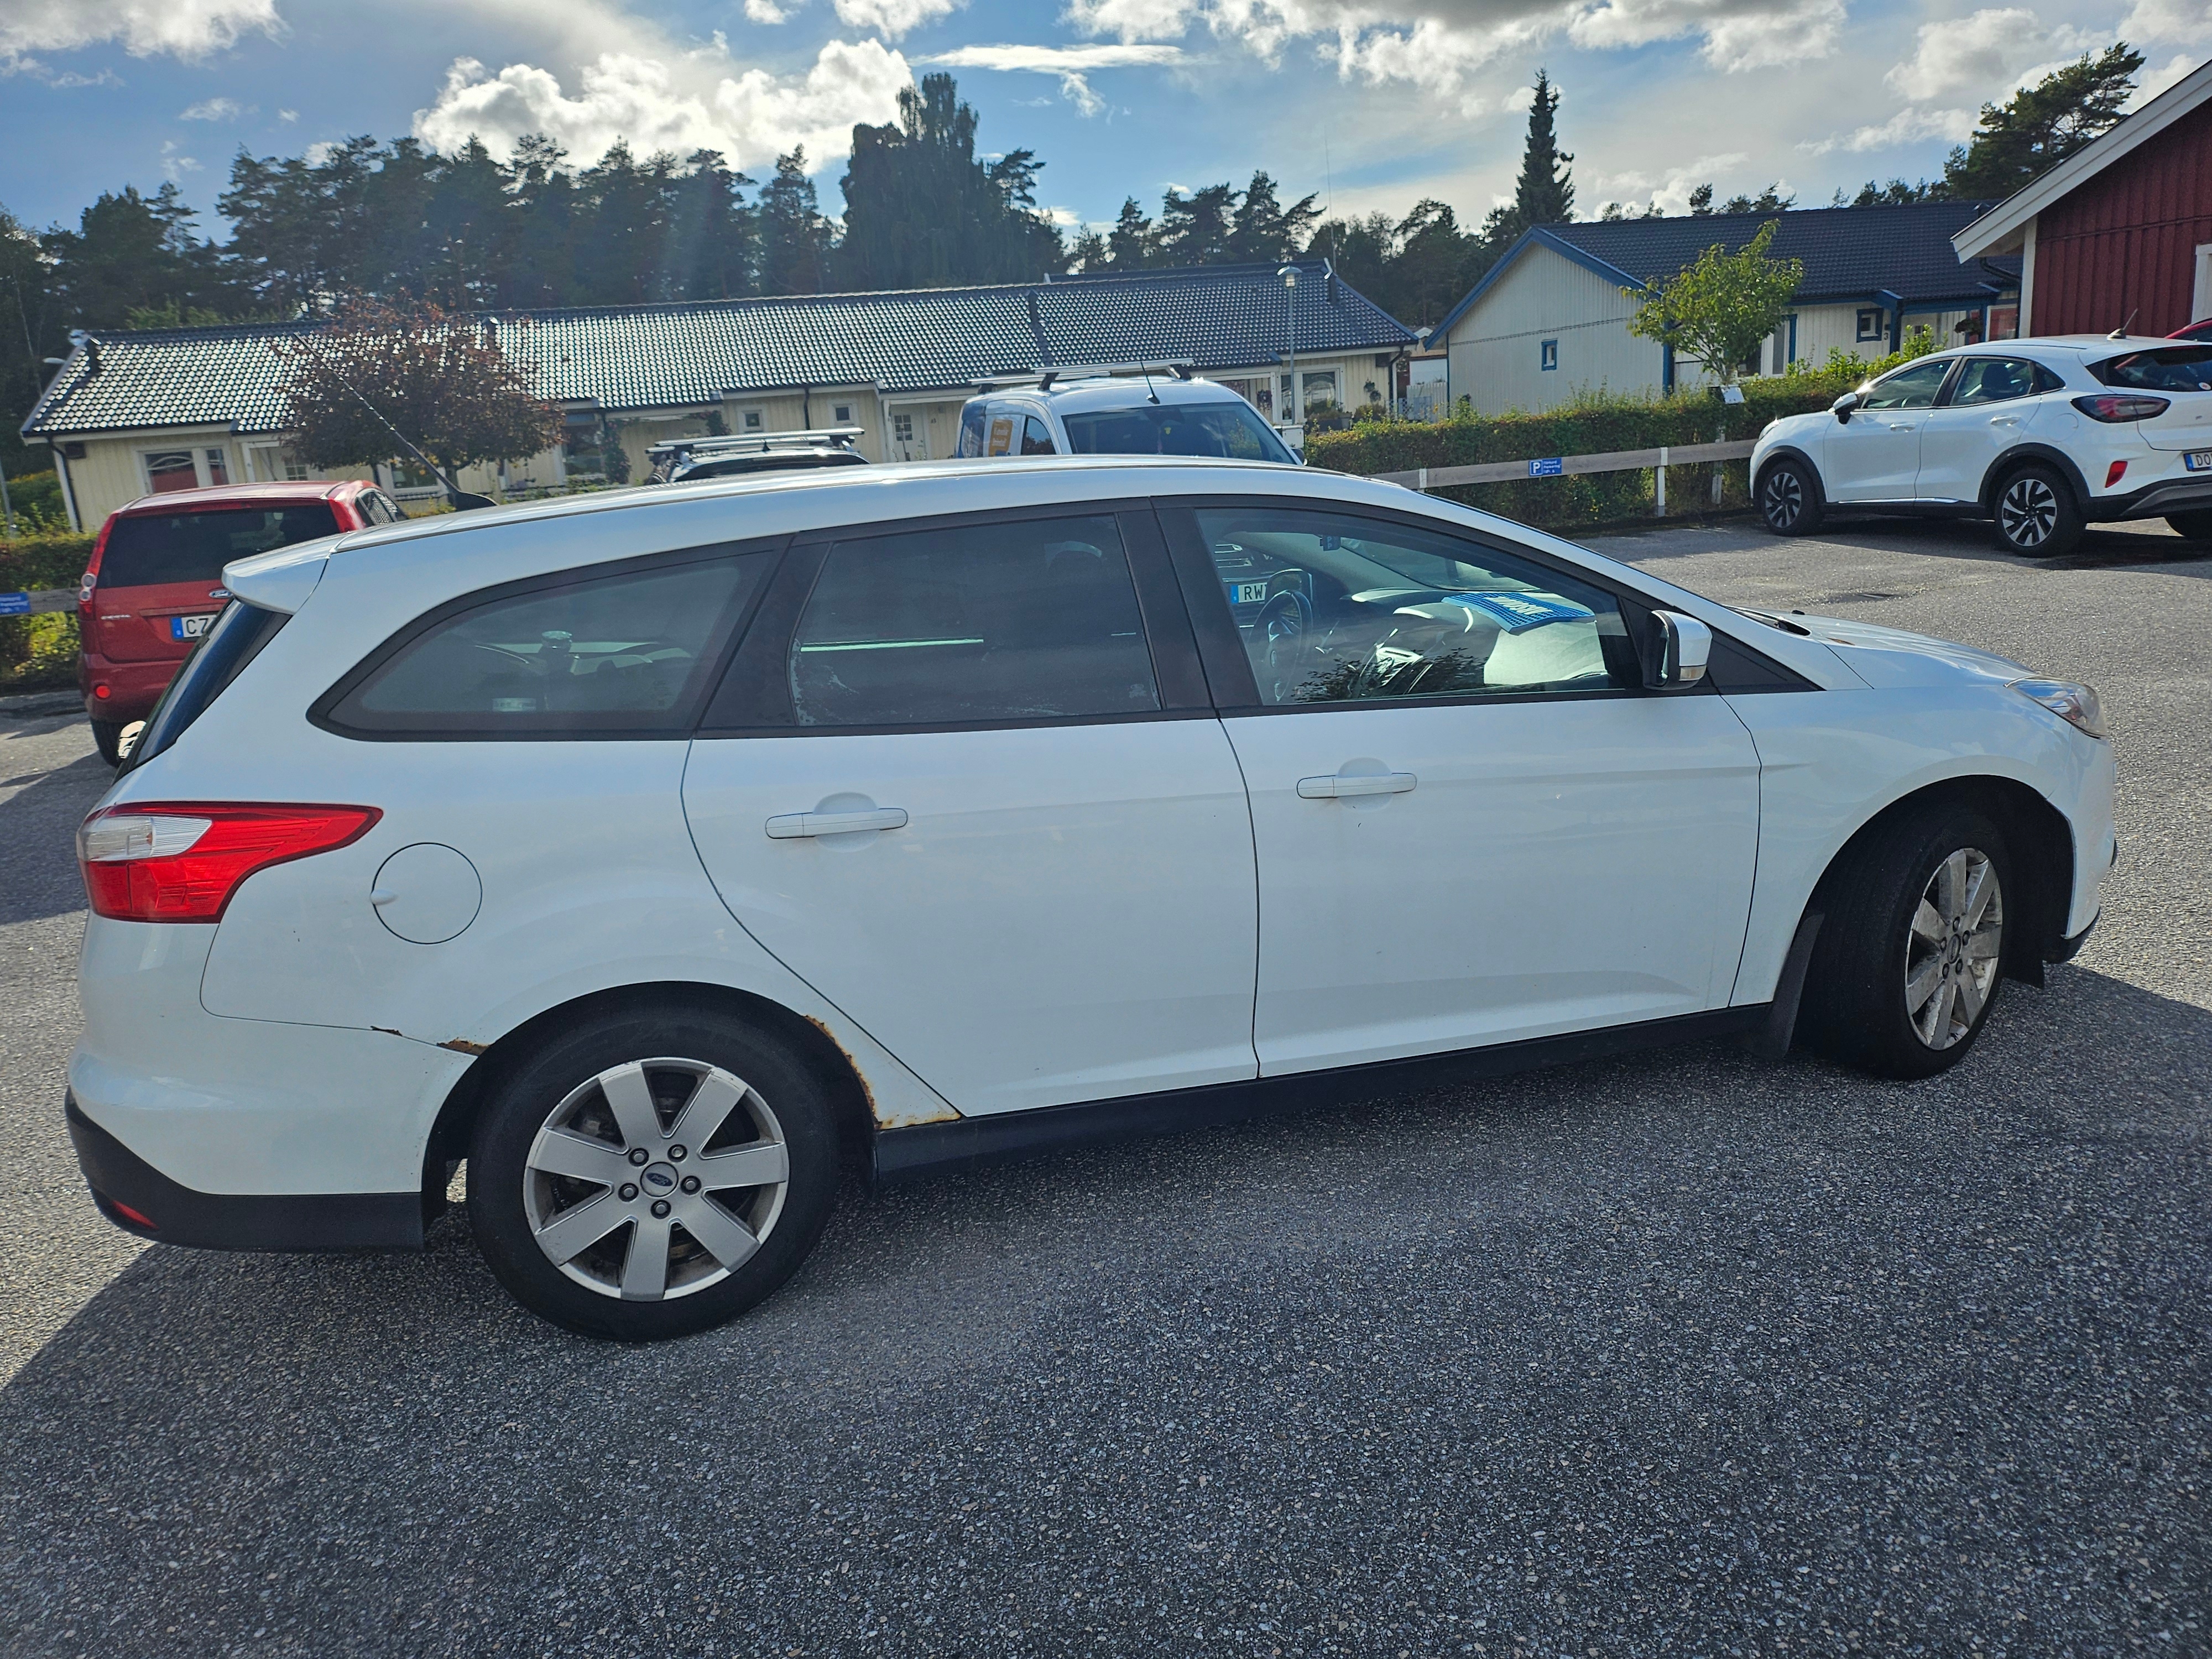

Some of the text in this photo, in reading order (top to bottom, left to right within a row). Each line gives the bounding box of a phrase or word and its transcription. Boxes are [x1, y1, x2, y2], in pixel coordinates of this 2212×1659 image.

[2195, 453, 2212, 466] DO
[1532, 462, 1541, 474] P
[1244, 584, 1267, 601] RW
